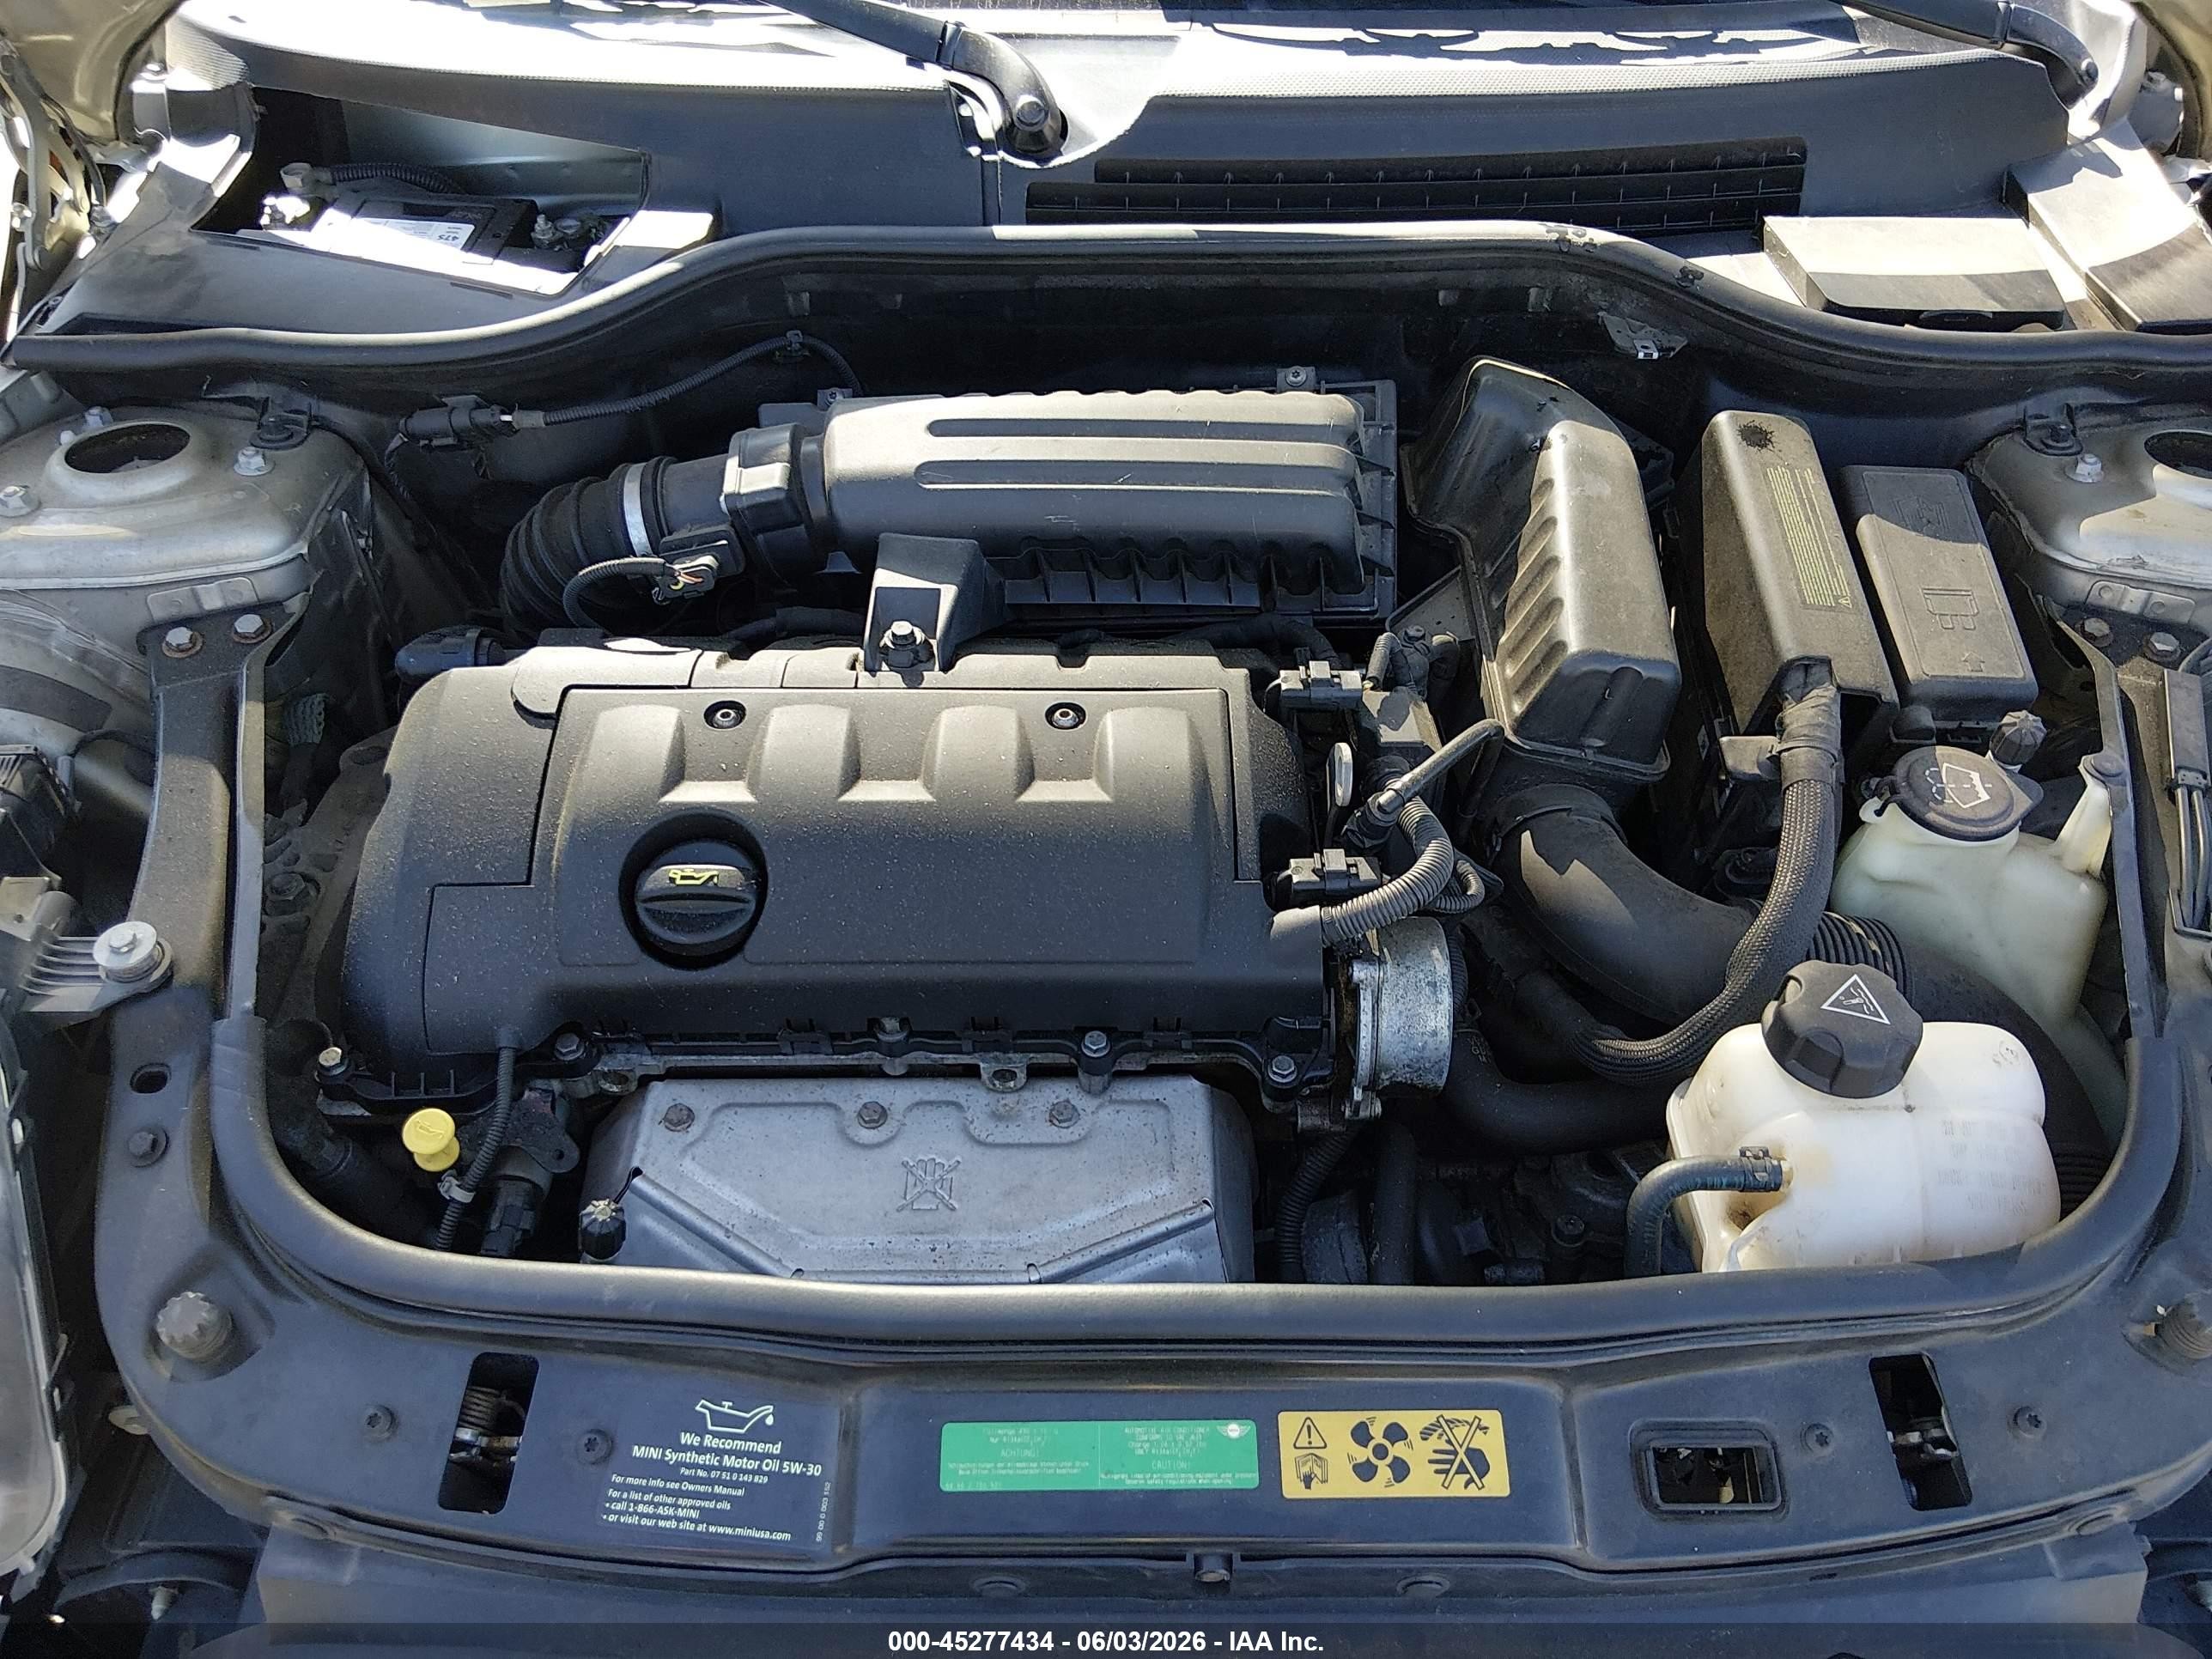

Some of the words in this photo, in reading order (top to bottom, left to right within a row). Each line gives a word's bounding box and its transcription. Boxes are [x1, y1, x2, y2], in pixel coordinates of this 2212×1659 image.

[680, 1431, 701, 1446] We
[703, 1434, 782, 1455] Recommend
[632, 1444, 663, 1460] MINI
[665, 1448, 720, 1466] Synthetic
[722, 1455, 760, 1470] Motor
[762, 1458, 781, 1473] Oil
[781, 1461, 823, 1477] 5W-30
[611, 1474, 625, 1484] For
[625, 1476, 647, 1486] more
[648, 1477, 665, 1488] info
[665, 1480, 680, 1490] see
[681, 1481, 713, 1493] Owners
[714, 1484, 745, 1498] Manual
[680, 1467, 696, 1477] Part
[696, 1468, 709, 1478] No.
[710, 1469, 720, 1480] 07
[721, 1471, 731, 1480] 51
[732, 1472, 738, 1480] 0
[739, 1473, 753, 1482] 143
[754, 1474, 769, 1484] 829
[607, 1488, 621, 1498] For
[629, 1490, 642, 1501] list
[643, 1492, 654, 1501] of
[653, 1493, 677, 1504] other
[678, 1498, 715, 1509] approved
[716, 1500, 732, 1510] oils
[610, 1501, 628, 1511] call
[628, 1502, 701, 1519] 1-866-ASK-MINI
[620, 1514, 640, 1525] visit
[640, 1517, 657, 1527] our
[658, 1518, 678, 1528] web
[678, 1520, 696, 1531] site
[696, 1522, 708, 1532] at
[708, 1523, 792, 1542] www.miniusa.com
